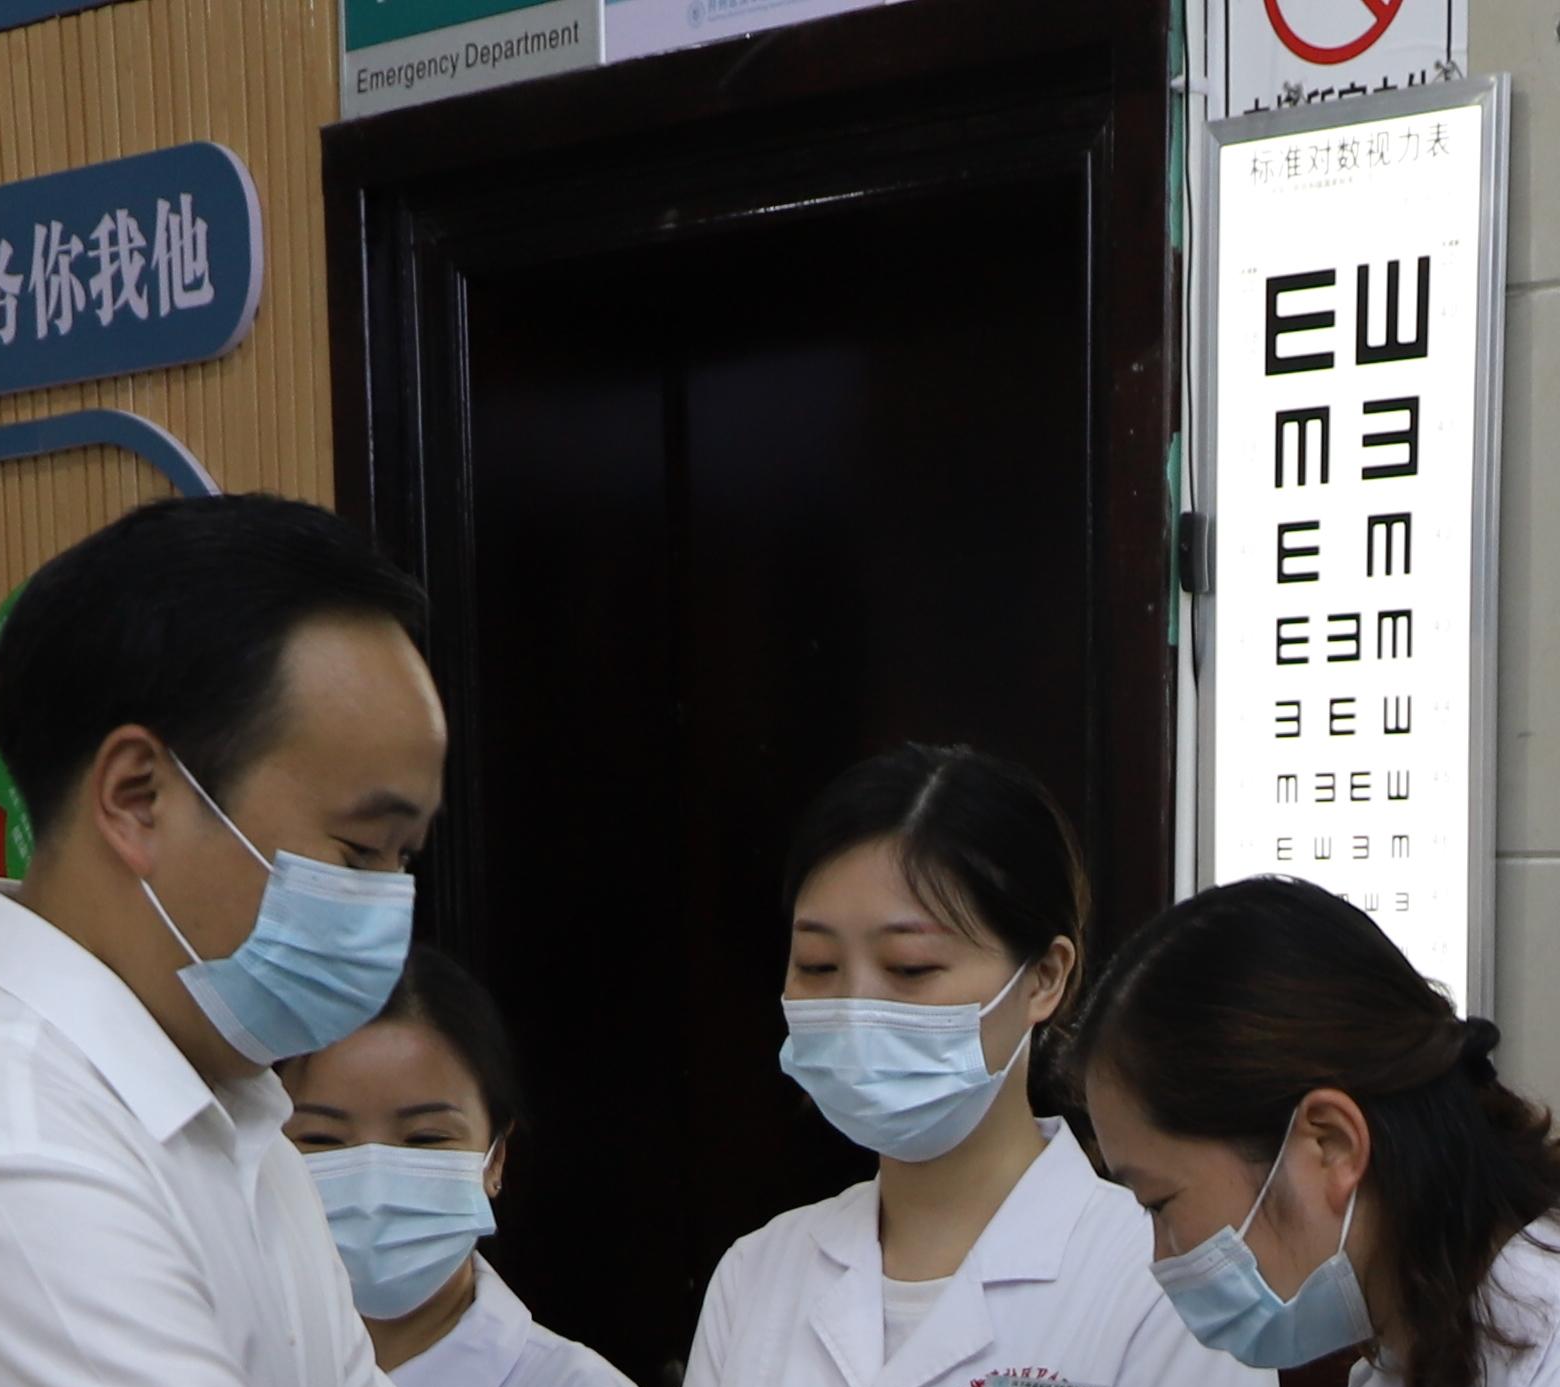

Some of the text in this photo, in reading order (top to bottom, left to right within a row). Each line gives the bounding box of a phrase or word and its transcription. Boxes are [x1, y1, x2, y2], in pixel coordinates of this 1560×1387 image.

[356, 21, 582, 95] Emergency Department
[1249, 123, 1451, 186] 标准对数视力表
